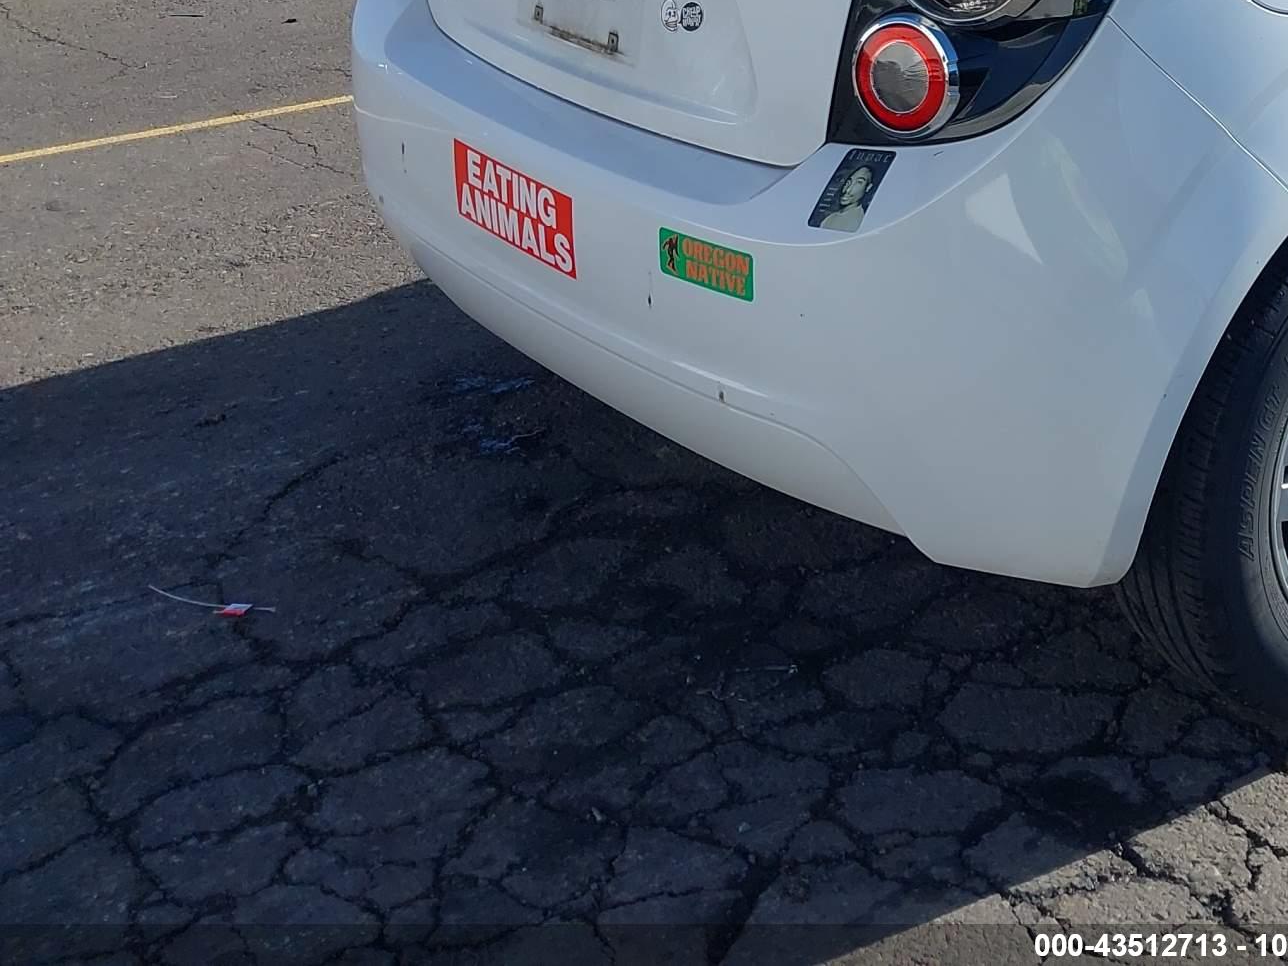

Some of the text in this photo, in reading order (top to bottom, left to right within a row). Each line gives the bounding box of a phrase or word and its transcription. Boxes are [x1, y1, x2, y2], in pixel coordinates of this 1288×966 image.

[466, 148, 558, 230] EATING
[460, 182, 573, 274] ANIMALS
[681, 237, 750, 278] OREGON
[685, 259, 746, 297] NATIVE
